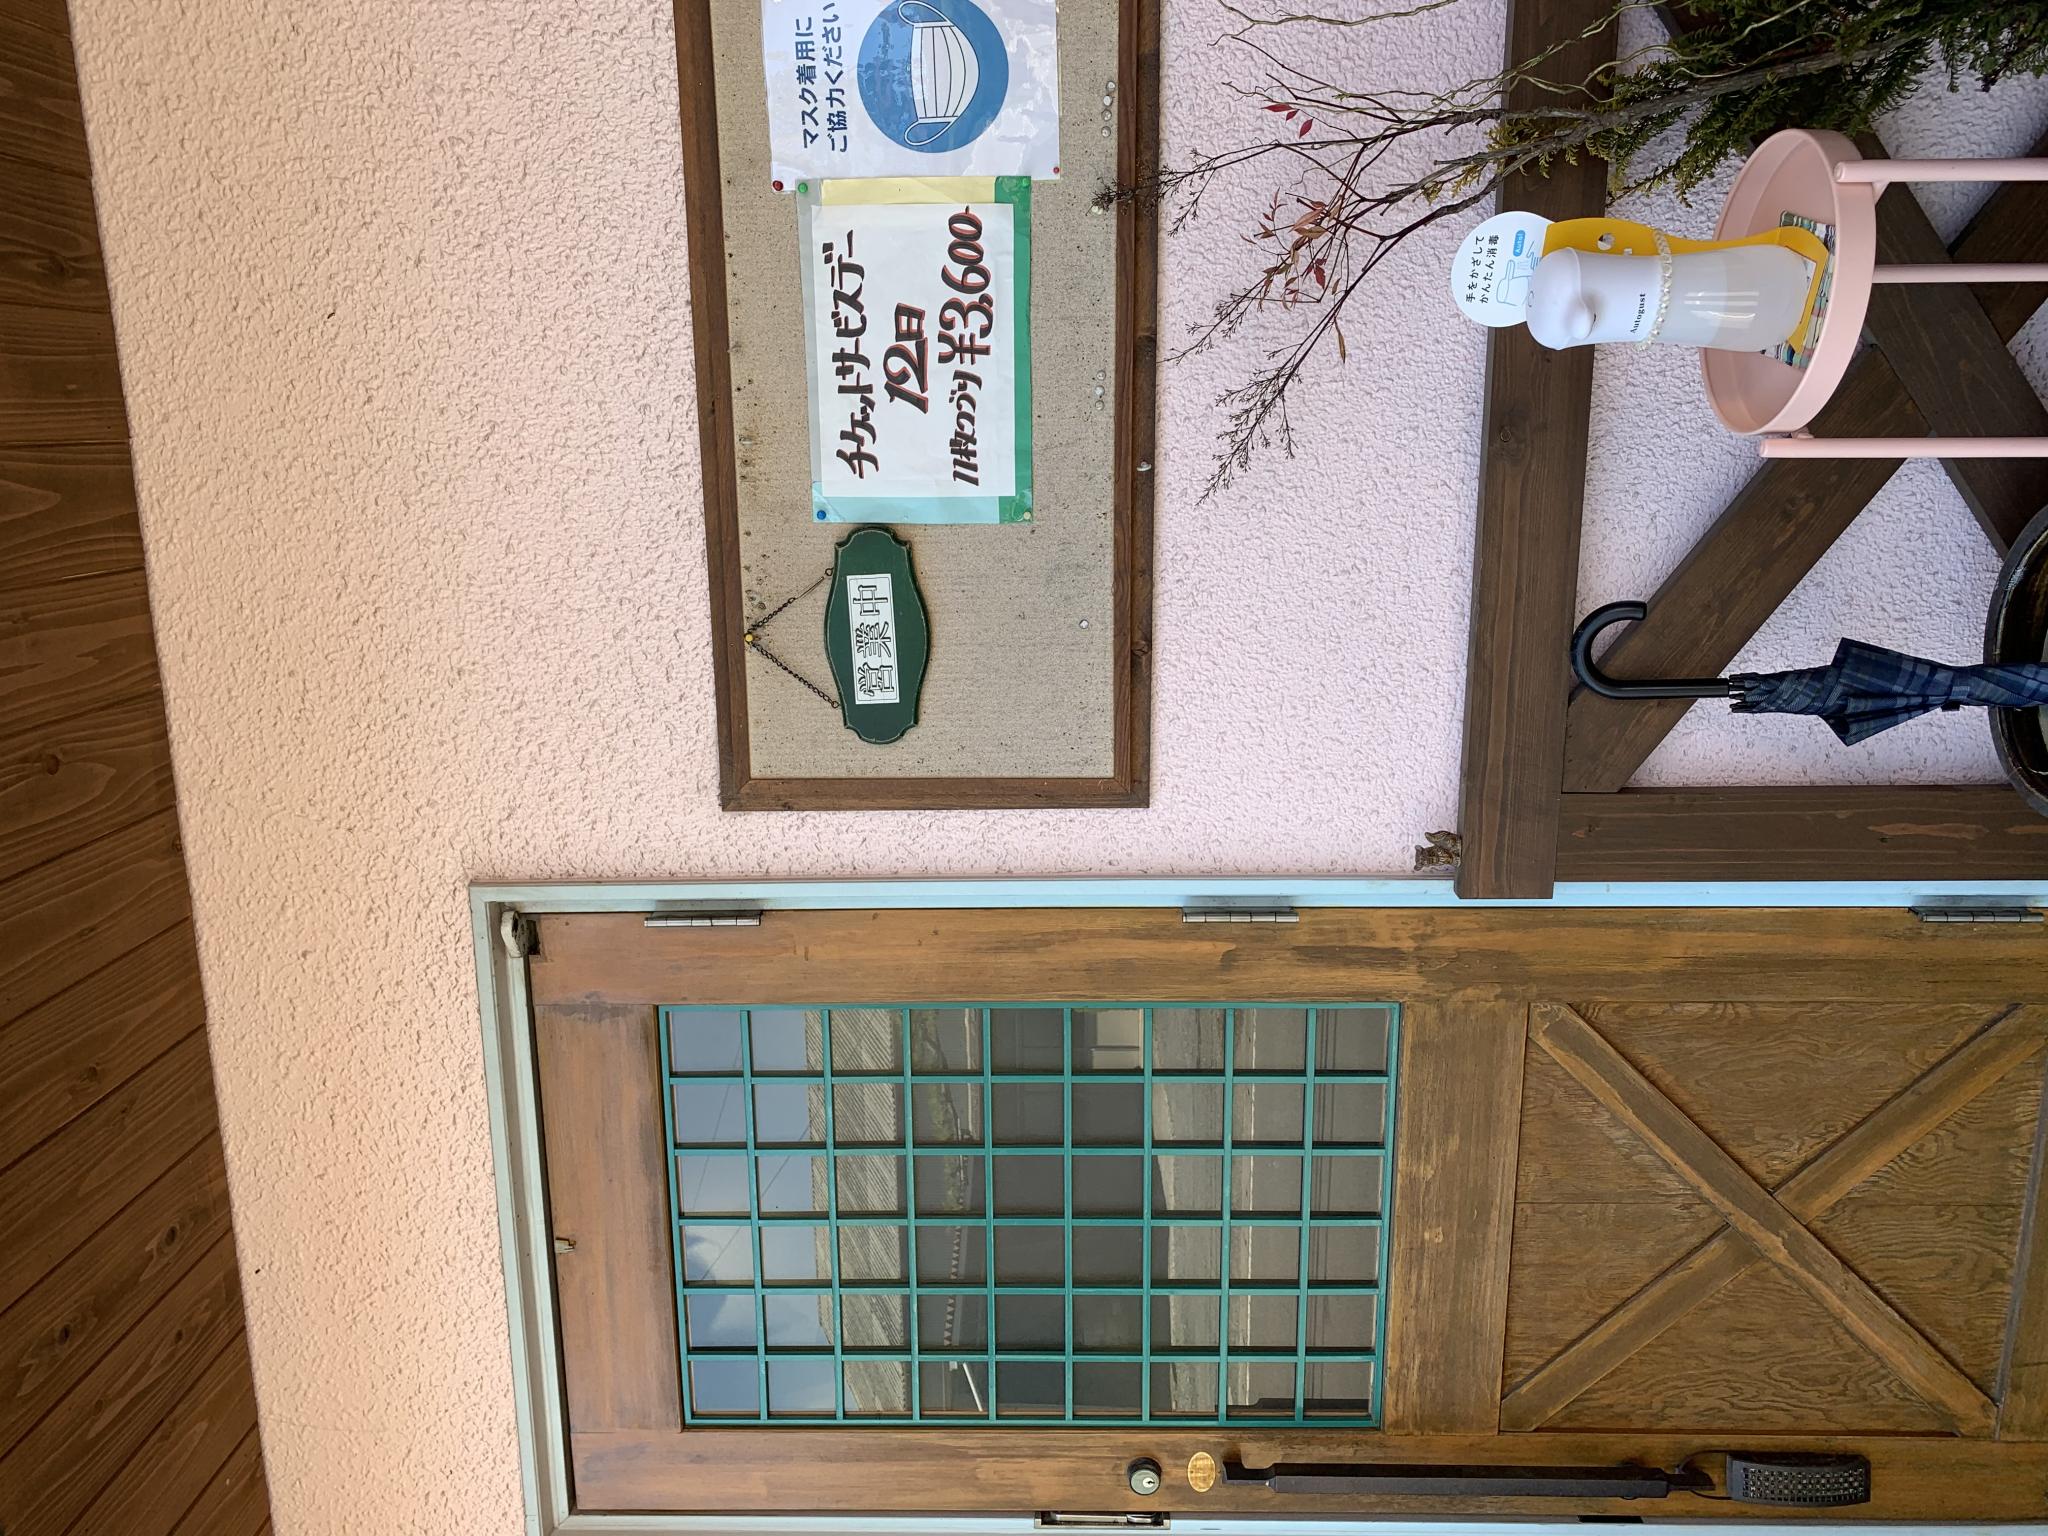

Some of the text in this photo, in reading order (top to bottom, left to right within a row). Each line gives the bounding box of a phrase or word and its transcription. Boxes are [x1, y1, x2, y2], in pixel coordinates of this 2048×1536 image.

[795, 16, 819, 149] マスク着用に
[822, 2, 848, 153] ご協力ください
[1465, 235, 1485, 303] 手をかざして
[1479, 234, 1500, 304] かんたん消毒
[1630, 292, 1647, 334] Autogust
[822, 229, 880, 479] チケットサービスデー
[883, 302, 929, 415] 12日
[948, 369, 983, 487] 11枚つづり
[852, 584, 895, 697] 営業中
